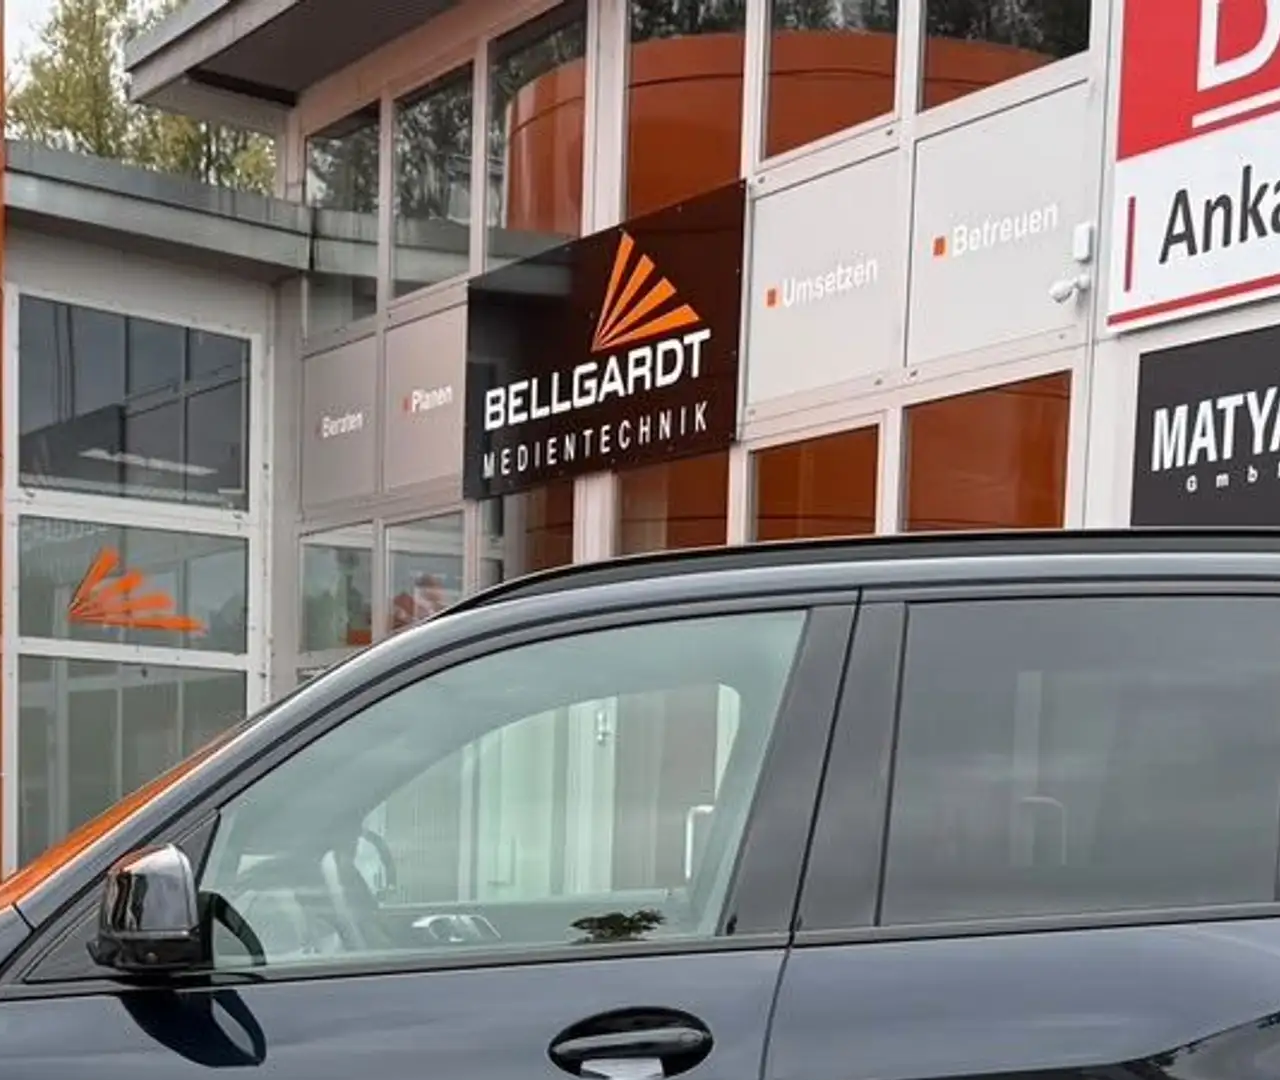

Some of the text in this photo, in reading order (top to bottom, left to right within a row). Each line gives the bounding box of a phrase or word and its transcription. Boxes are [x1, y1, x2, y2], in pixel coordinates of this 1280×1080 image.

[951, 202, 1058, 257] Betreuen
[782, 257, 879, 307] Umsetzen
[484, 328, 711, 431] BELLGARDT
[482, 401, 709, 480] MEDIENTECHNIK
